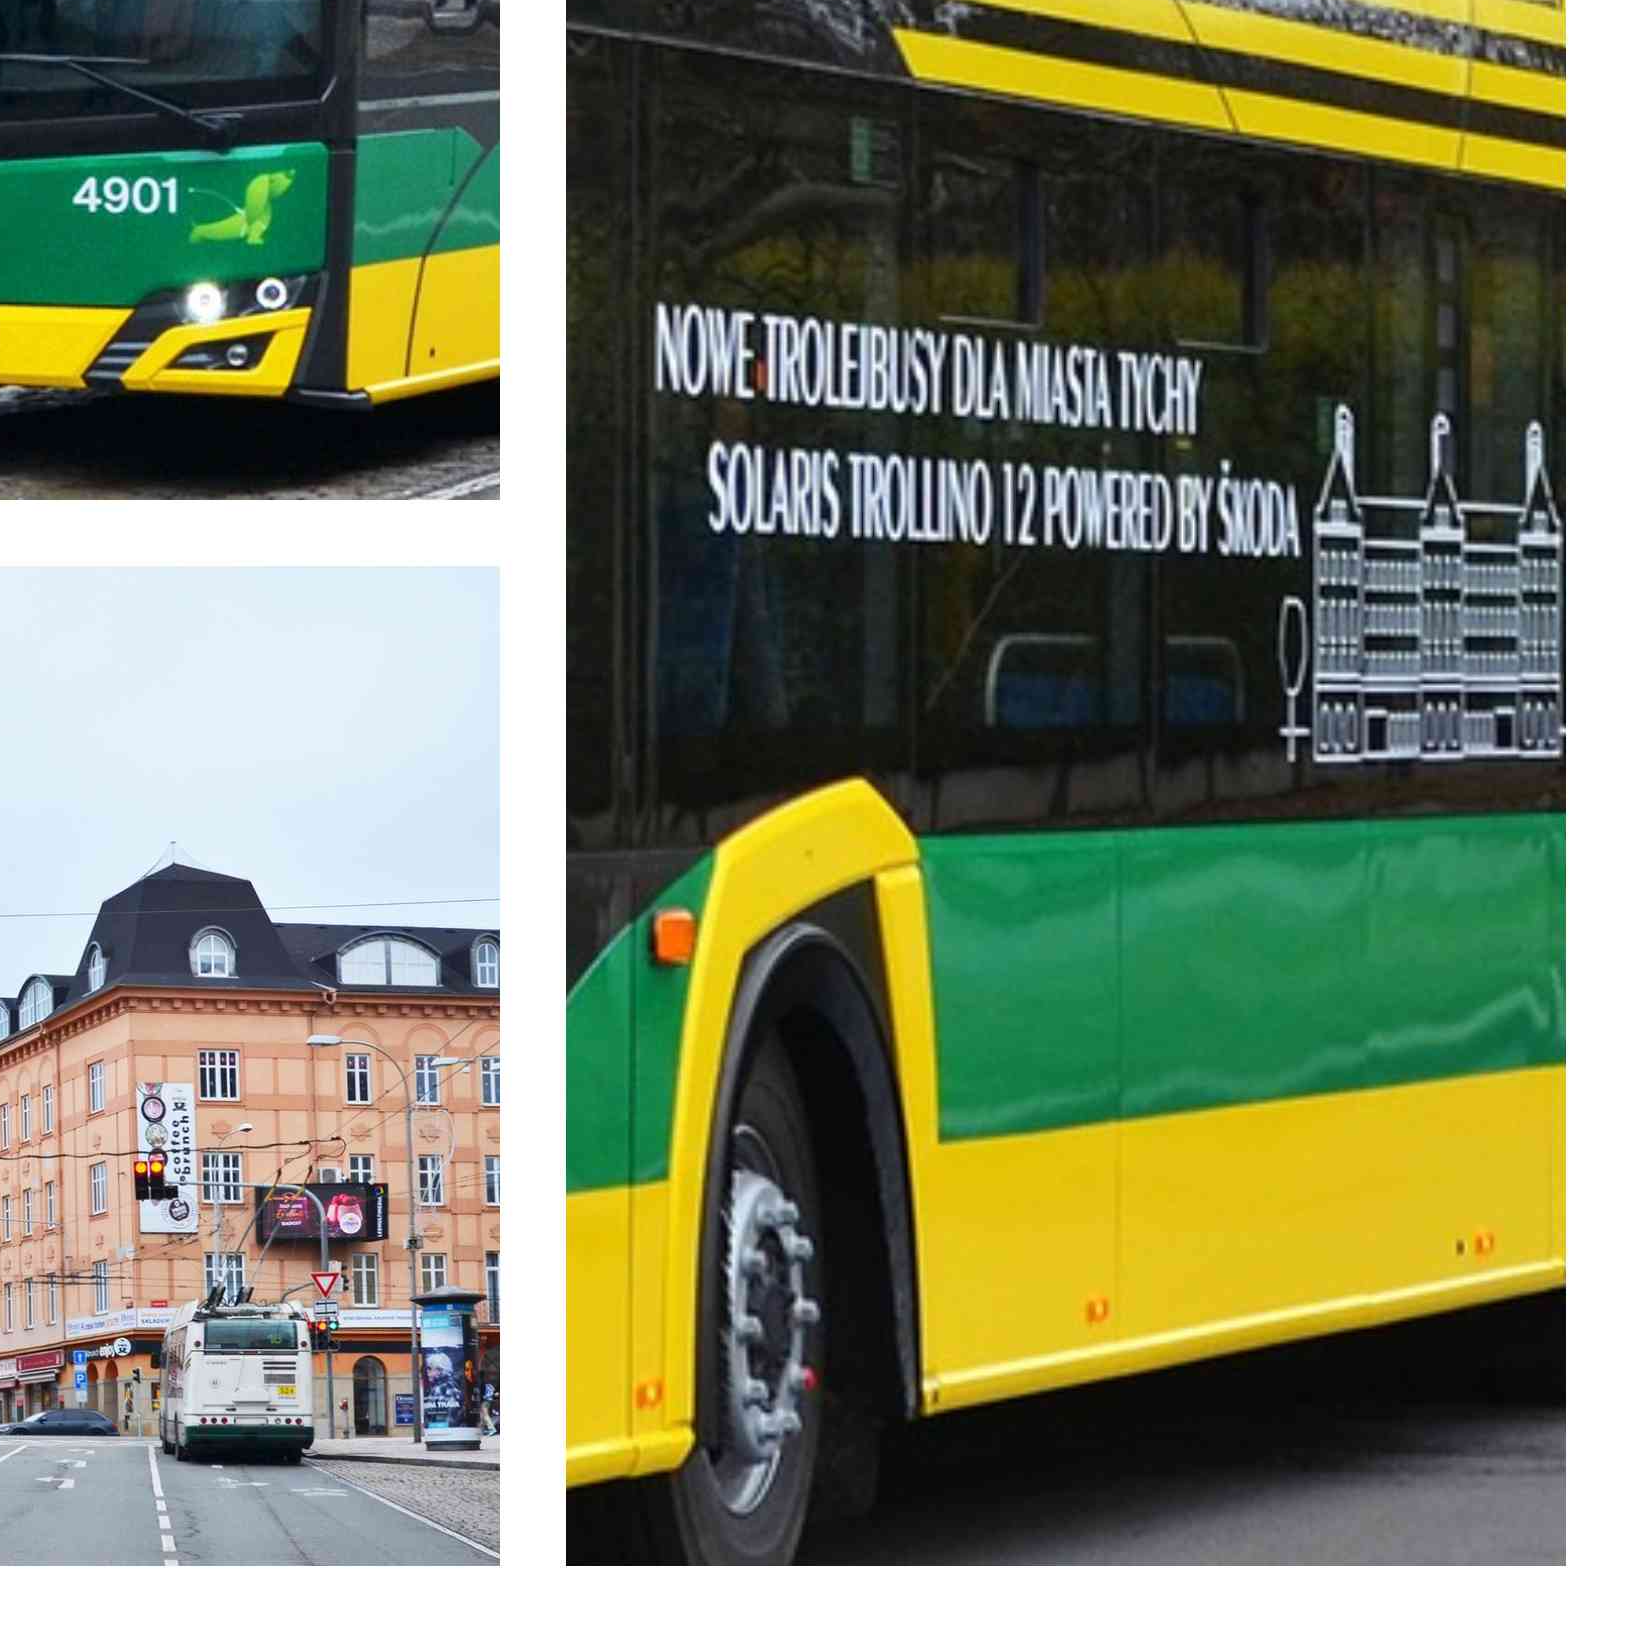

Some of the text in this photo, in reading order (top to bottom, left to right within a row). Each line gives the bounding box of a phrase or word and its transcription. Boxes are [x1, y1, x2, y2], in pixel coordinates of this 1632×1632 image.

[72, 176, 177, 214] 4901
[656, 304, 1202, 436] NOWE TROLEJBUSY DLA MIASTA TYCHY
[708, 440, 1301, 558] SOLARIS TROLLINO 12 POWERED BY ŠKODA
[170, 1120, 182, 1175] coffee
[179, 1115, 191, 1175] brunch
